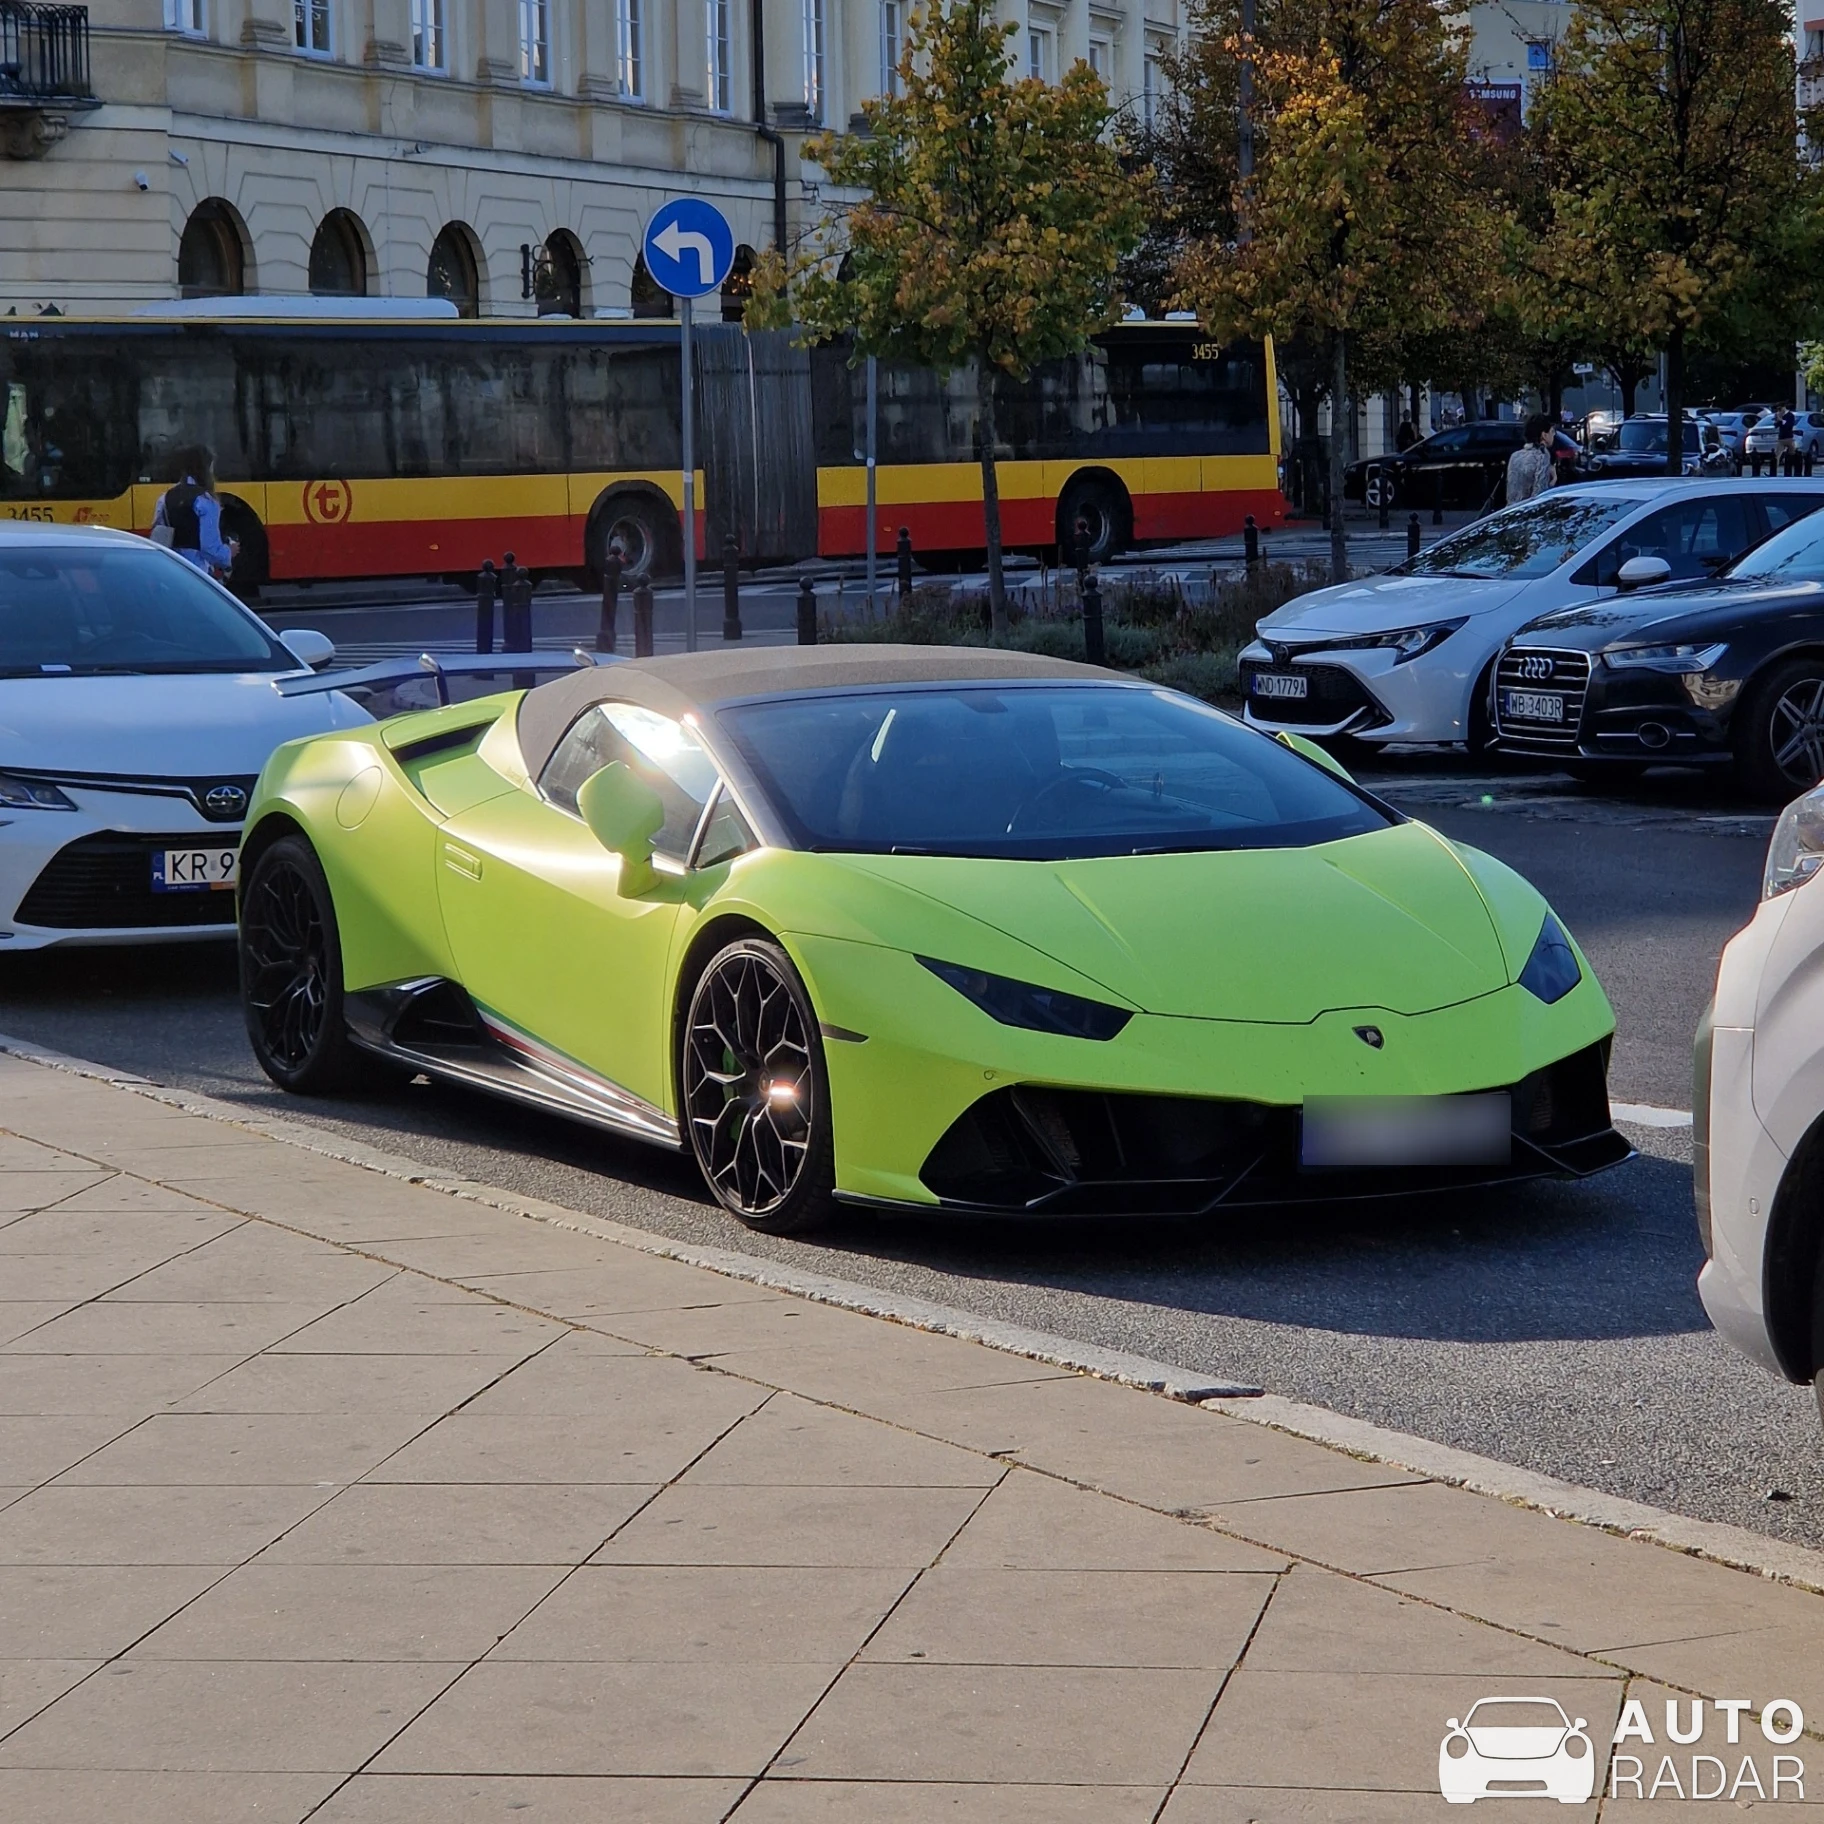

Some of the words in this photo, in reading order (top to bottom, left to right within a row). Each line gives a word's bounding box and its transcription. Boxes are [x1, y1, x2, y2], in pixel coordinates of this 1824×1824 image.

[1469, 89, 1517, 99] SMSUNG
[1192, 344, 1219, 360] 3455
[7, 507, 54, 522] 3455
[1277, 679, 1306, 696] 1779A
[1511, 694, 1526, 714] WB
[1529, 696, 1562, 718] 3403R
[171, 853, 207, 881] KR
